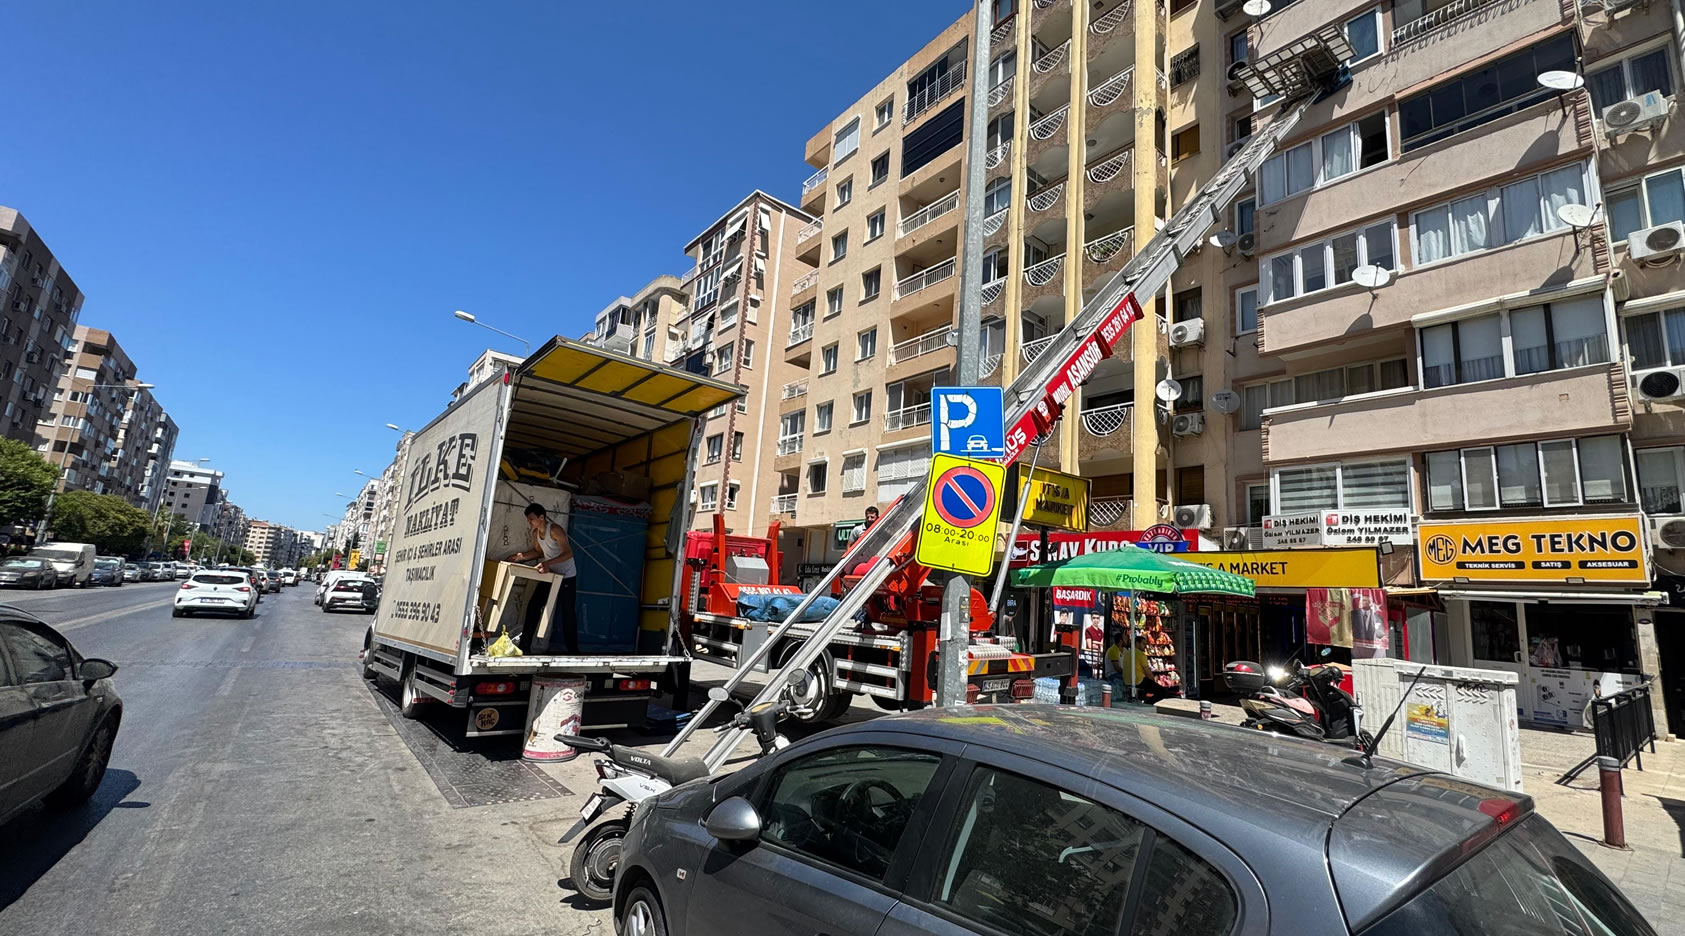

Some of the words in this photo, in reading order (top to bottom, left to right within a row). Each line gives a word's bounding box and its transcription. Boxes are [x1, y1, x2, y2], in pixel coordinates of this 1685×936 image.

[1066, 340, 1103, 390] ASANSÖR
[939, 394, 977, 450] P
[404, 433, 478, 516] İLKE
[1061, 488, 1070, 500] A
[1036, 498, 1074, 516] MARKET
[404, 497, 460, 539] NAKLİYAT
[1274, 517, 1287, 527] DİŞ
[1289, 515, 1319, 526] HEKİMİ
[1342, 514, 1361, 526] DİŞ
[1364, 513, 1408, 525] HEKİMİ
[837, 529, 853, 542] ULT
[926, 523, 990, 542] 08:00-20:00
[1285, 527, 1320, 537] YILMAZER
[1357, 526, 1409, 535] YILMAZER
[944, 536, 969, 546] Arası
[1148, 543, 1175, 553] VIP
[1461, 534, 1521, 555] MEG
[1530, 531, 1636, 554] TEKNO
[417, 541, 443, 563] ŞEHİRLER
[442, 537, 463, 556] ARASI
[1030, 540, 1080, 562] SNAV
[1429, 536, 1454, 562] MEG
[1229, 562, 1288, 575] MARKET
[1586, 560, 1630, 568] AKSESUAR
[405, 565, 437, 585] TAŞIMACILIK
[1116, 574, 1163, 588] #Probably
[1056, 589, 1092, 602] BAŞARDIK
[430, 602, 441, 623] 43
[630, 755, 652, 765] VOLTA
